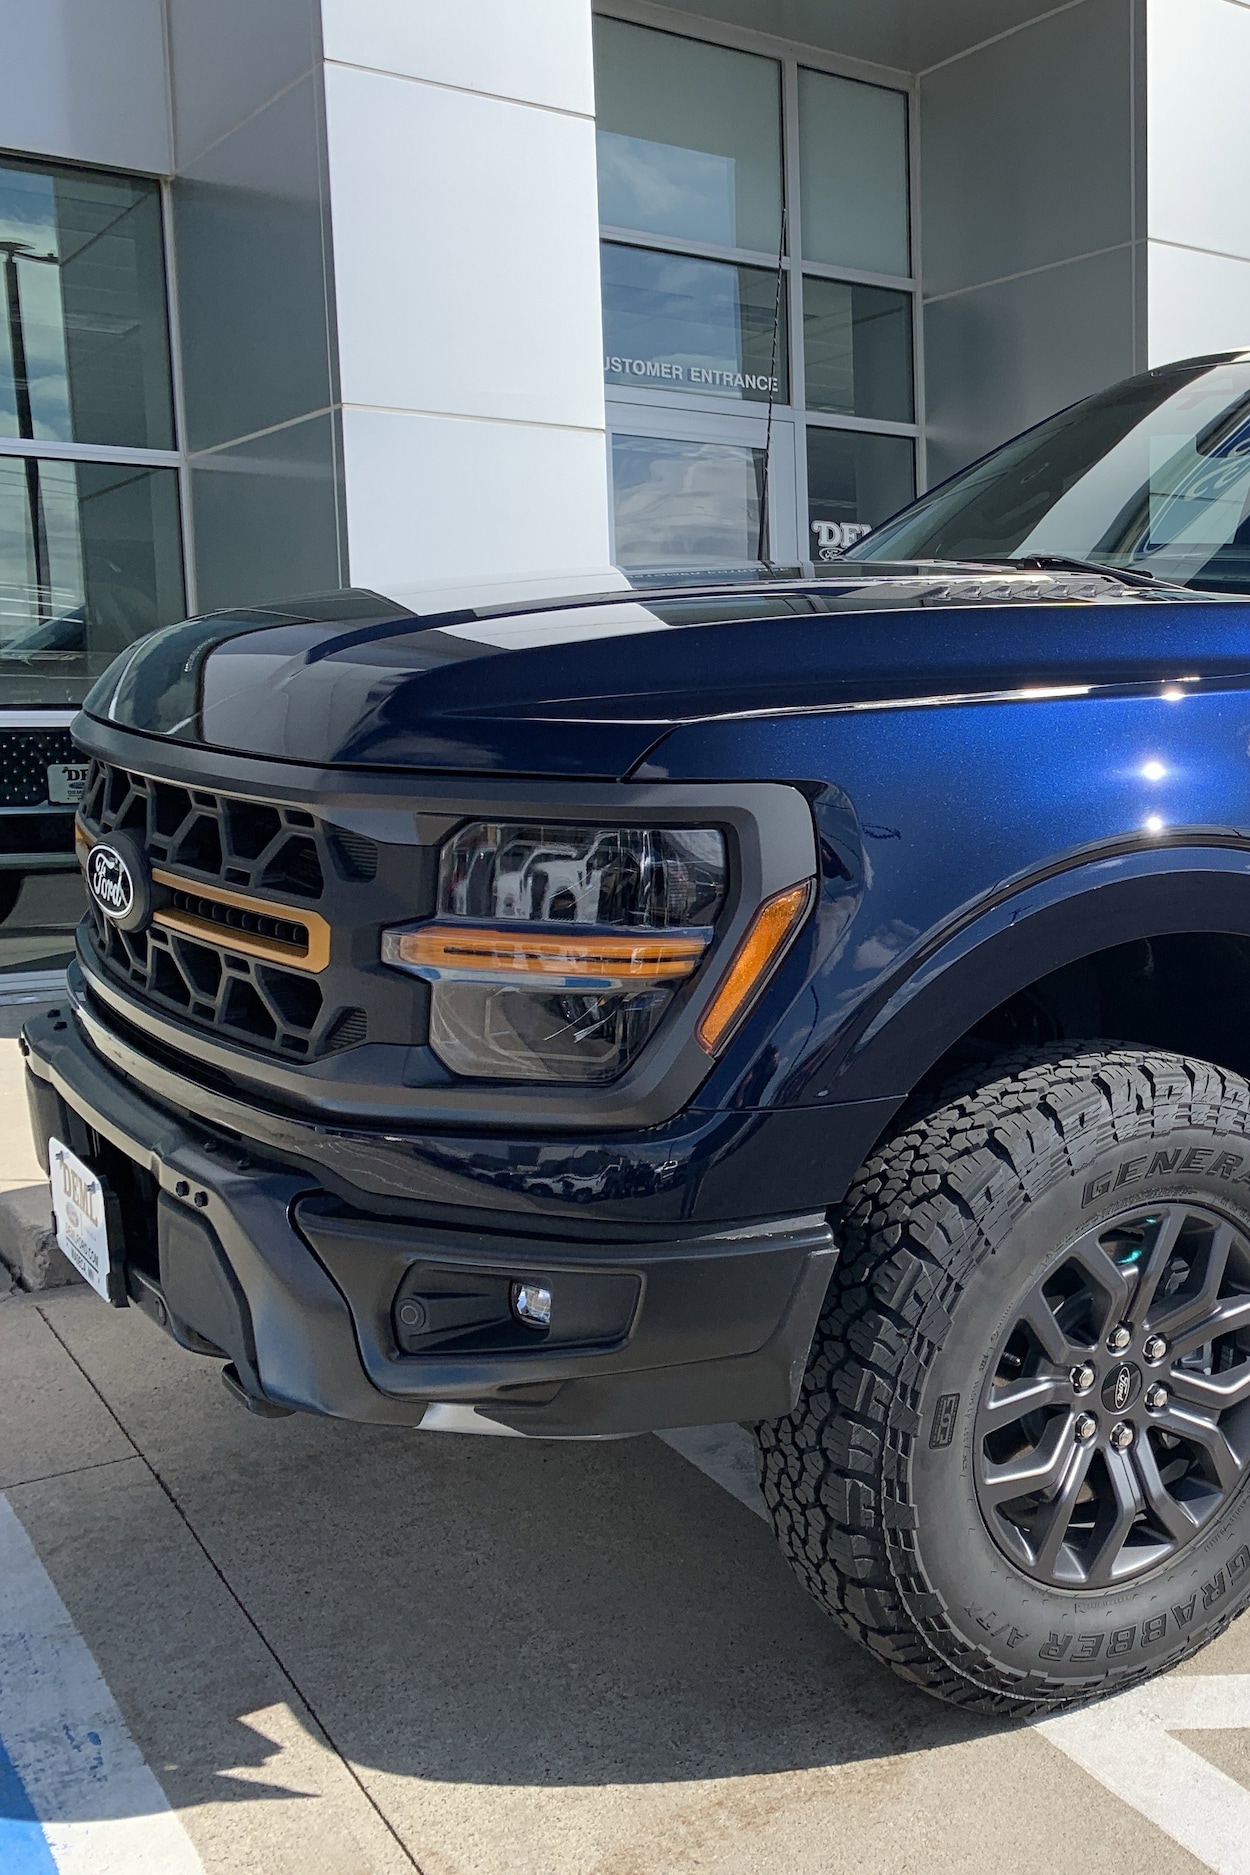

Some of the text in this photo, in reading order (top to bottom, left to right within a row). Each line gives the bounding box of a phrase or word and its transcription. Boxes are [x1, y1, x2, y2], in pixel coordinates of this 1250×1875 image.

[690, 367, 779, 393] ENTRANCE
[93, 853, 122, 907] Ford
[59, 1160, 98, 1228] DEML
